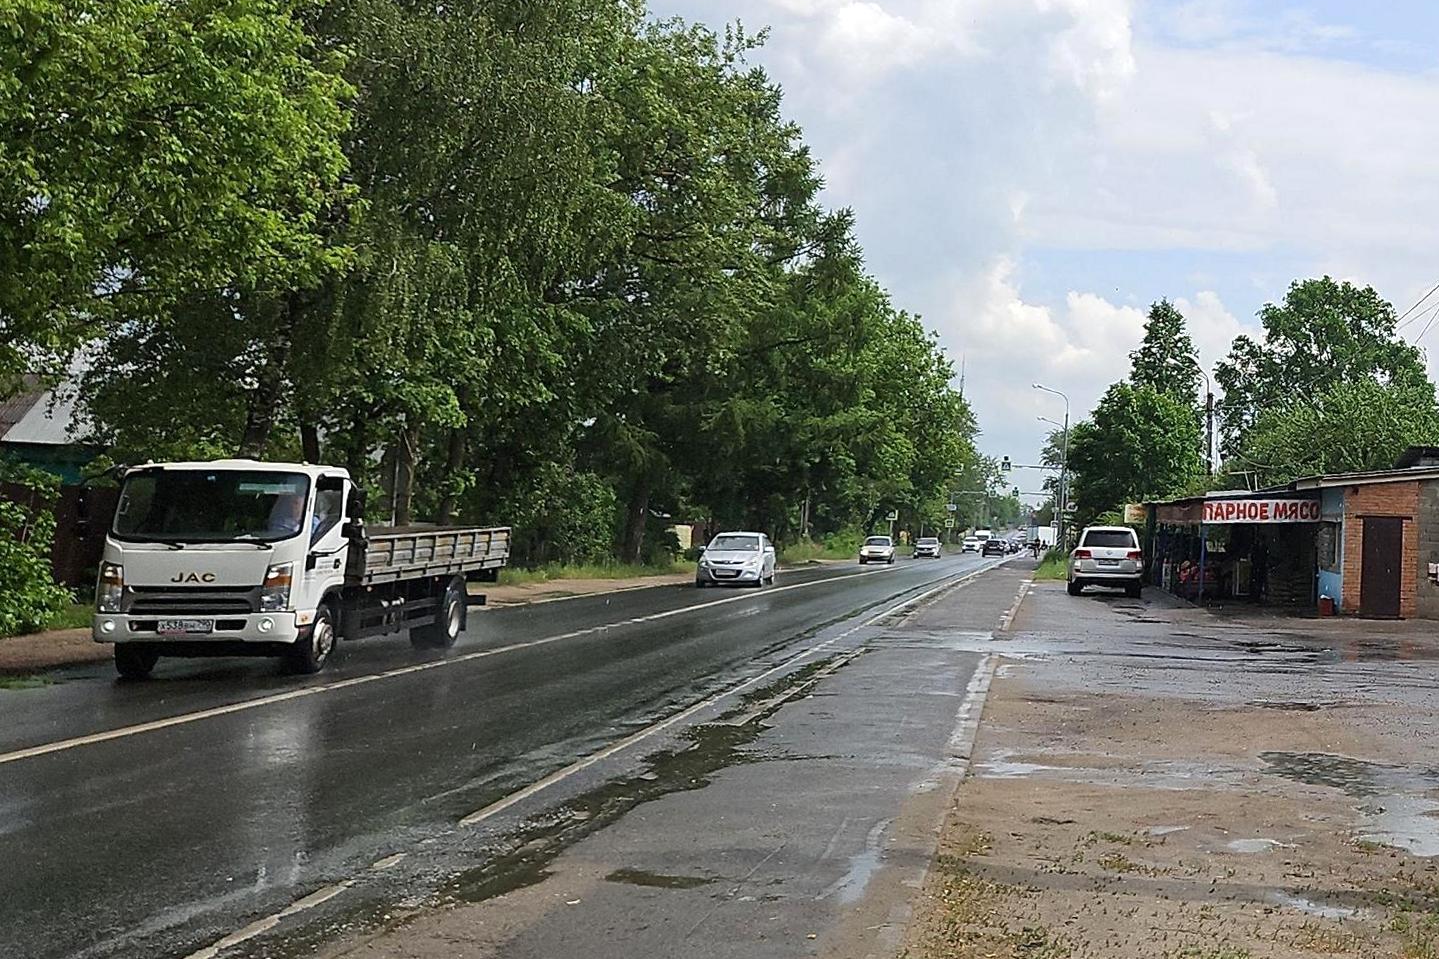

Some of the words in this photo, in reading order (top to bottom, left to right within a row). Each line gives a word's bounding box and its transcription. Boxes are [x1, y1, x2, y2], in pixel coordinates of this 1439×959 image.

[1202, 502, 1269, 521] ПАРНОЕ
[1273, 501, 1320, 520] МЯСО
[170, 572, 216, 583] JAC
